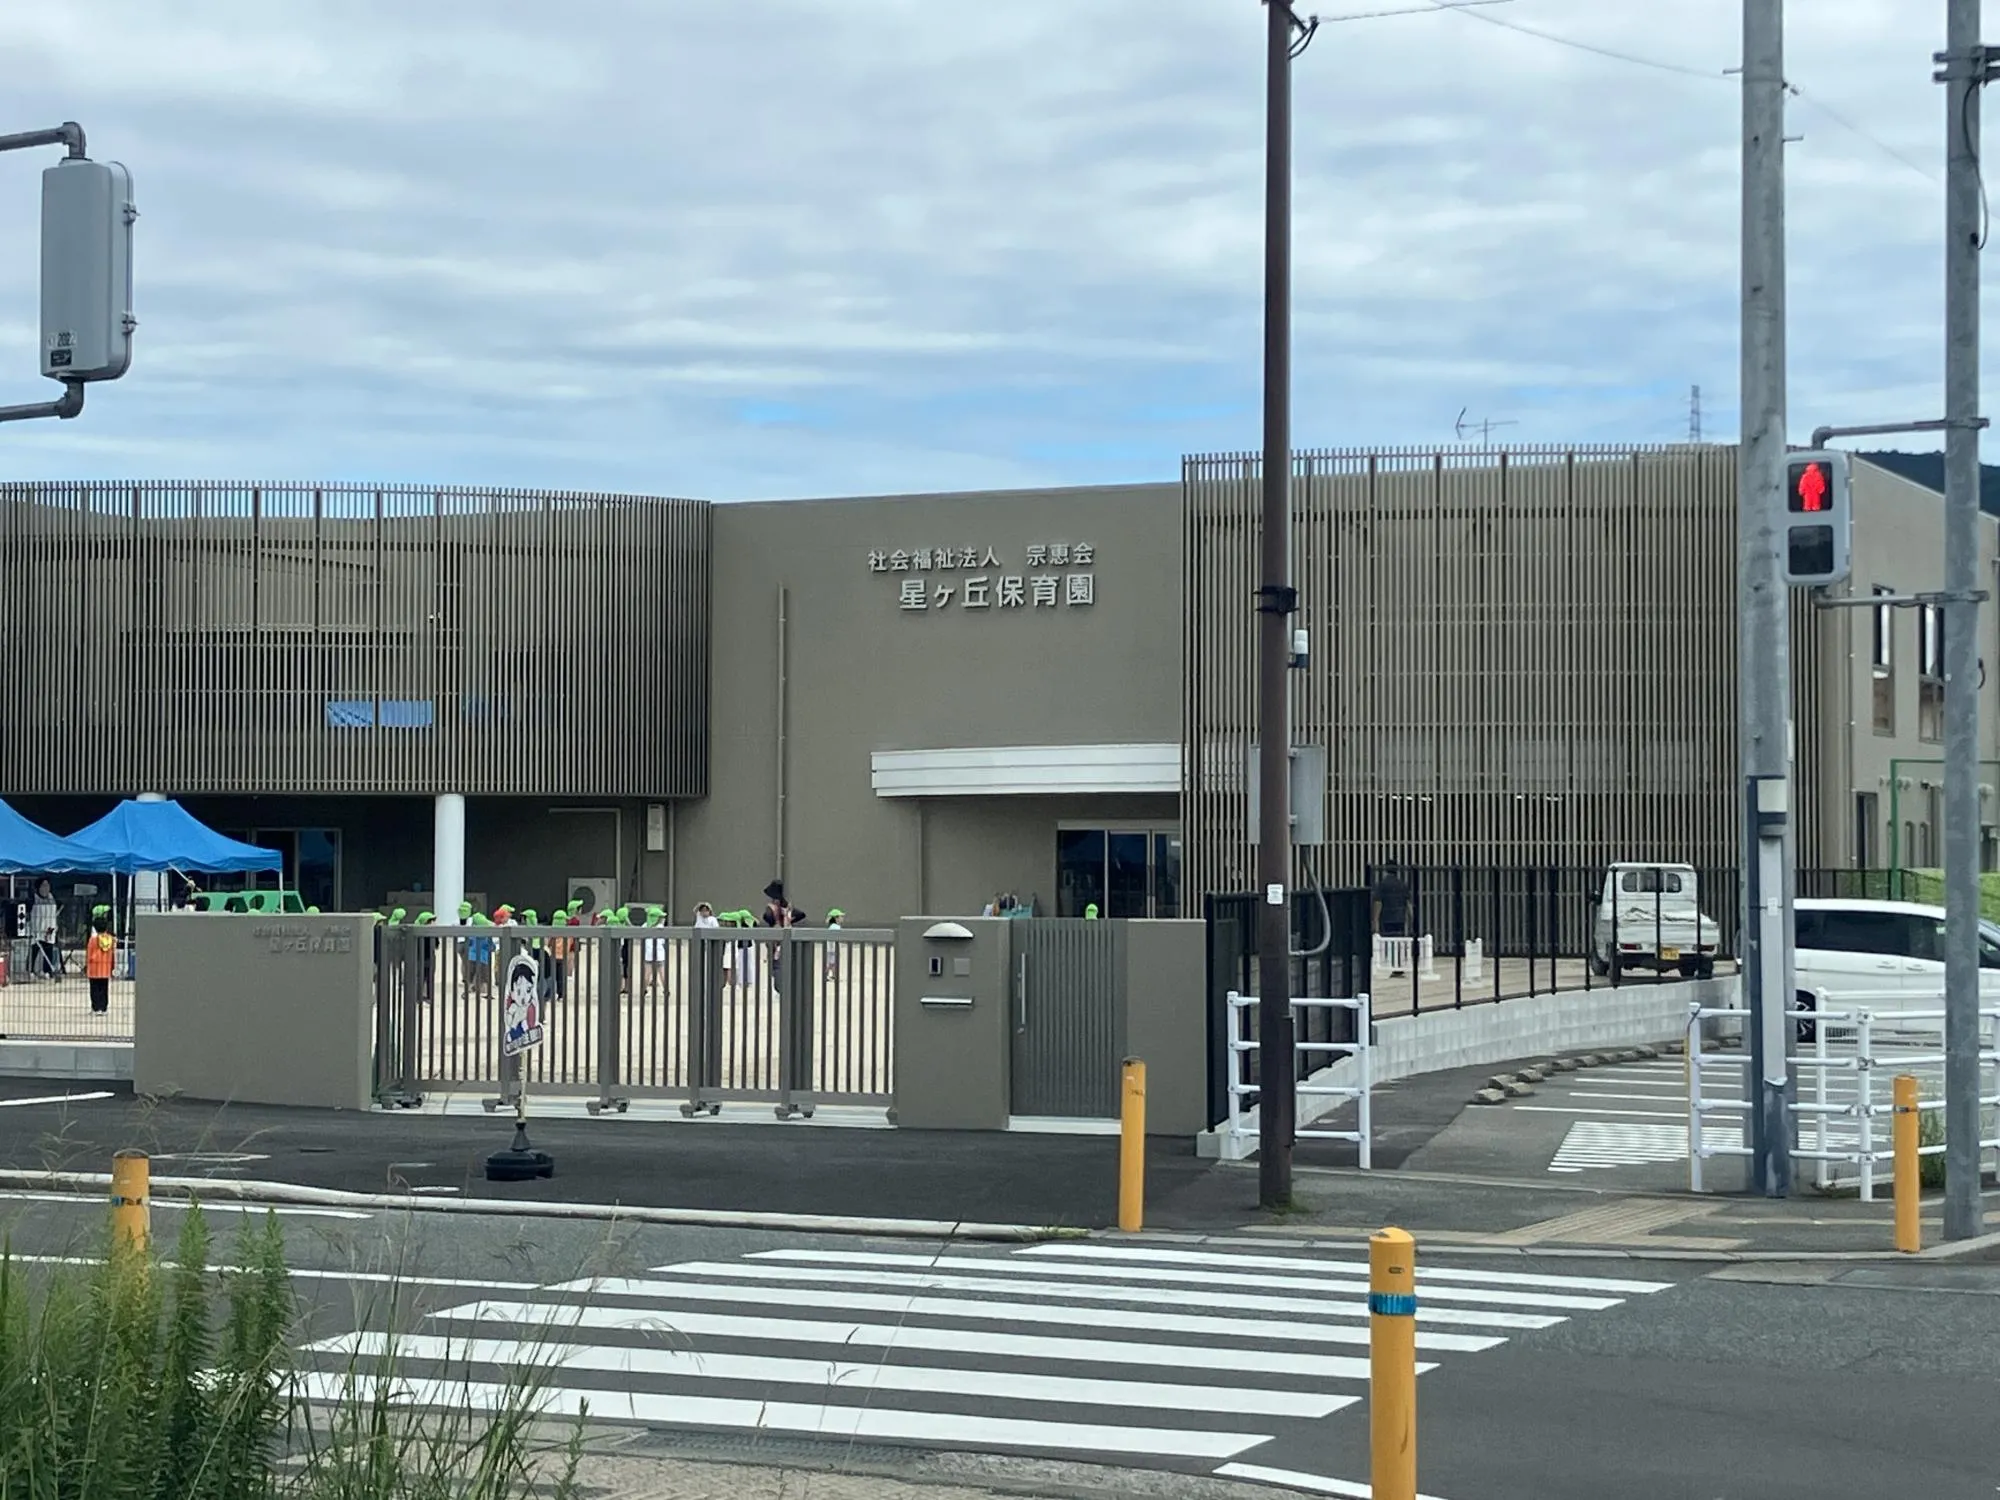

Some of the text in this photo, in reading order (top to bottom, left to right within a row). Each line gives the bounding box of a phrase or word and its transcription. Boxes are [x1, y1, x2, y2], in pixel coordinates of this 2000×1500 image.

[868, 545, 1001, 572] 社会福祉法人
